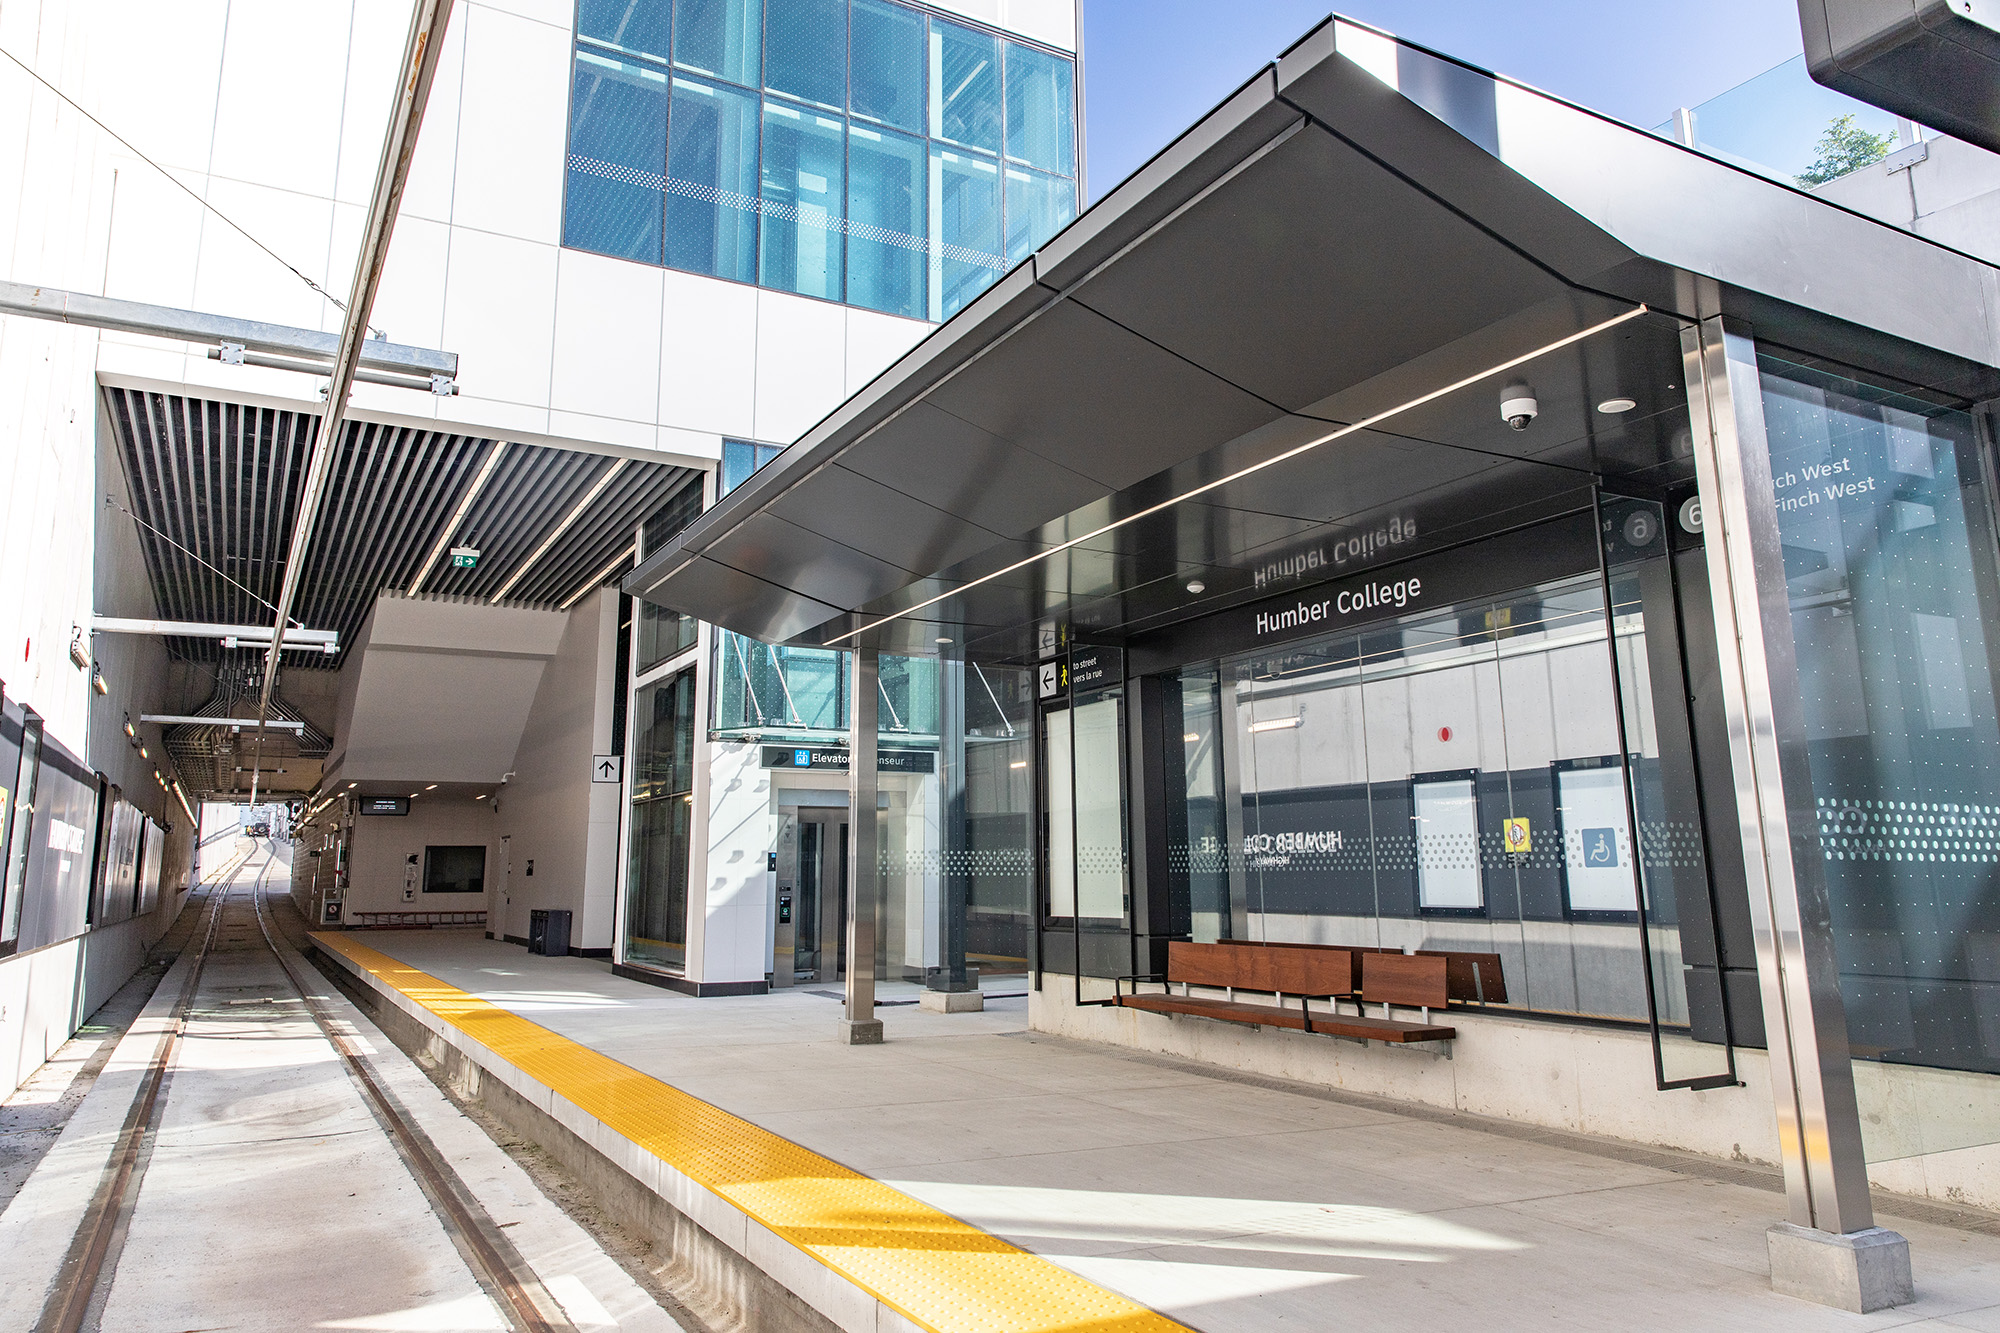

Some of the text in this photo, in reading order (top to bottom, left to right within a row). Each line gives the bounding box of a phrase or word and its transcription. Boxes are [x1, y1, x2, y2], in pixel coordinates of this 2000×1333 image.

[1801, 457, 1851, 481] West
[1825, 476, 1876, 501] West
[1256, 577, 1422, 635] Humber College
[1073, 657, 1097, 671] to street
[1073, 669, 1103, 684] vers la rue
[877, 757, 905, 766] nseur
